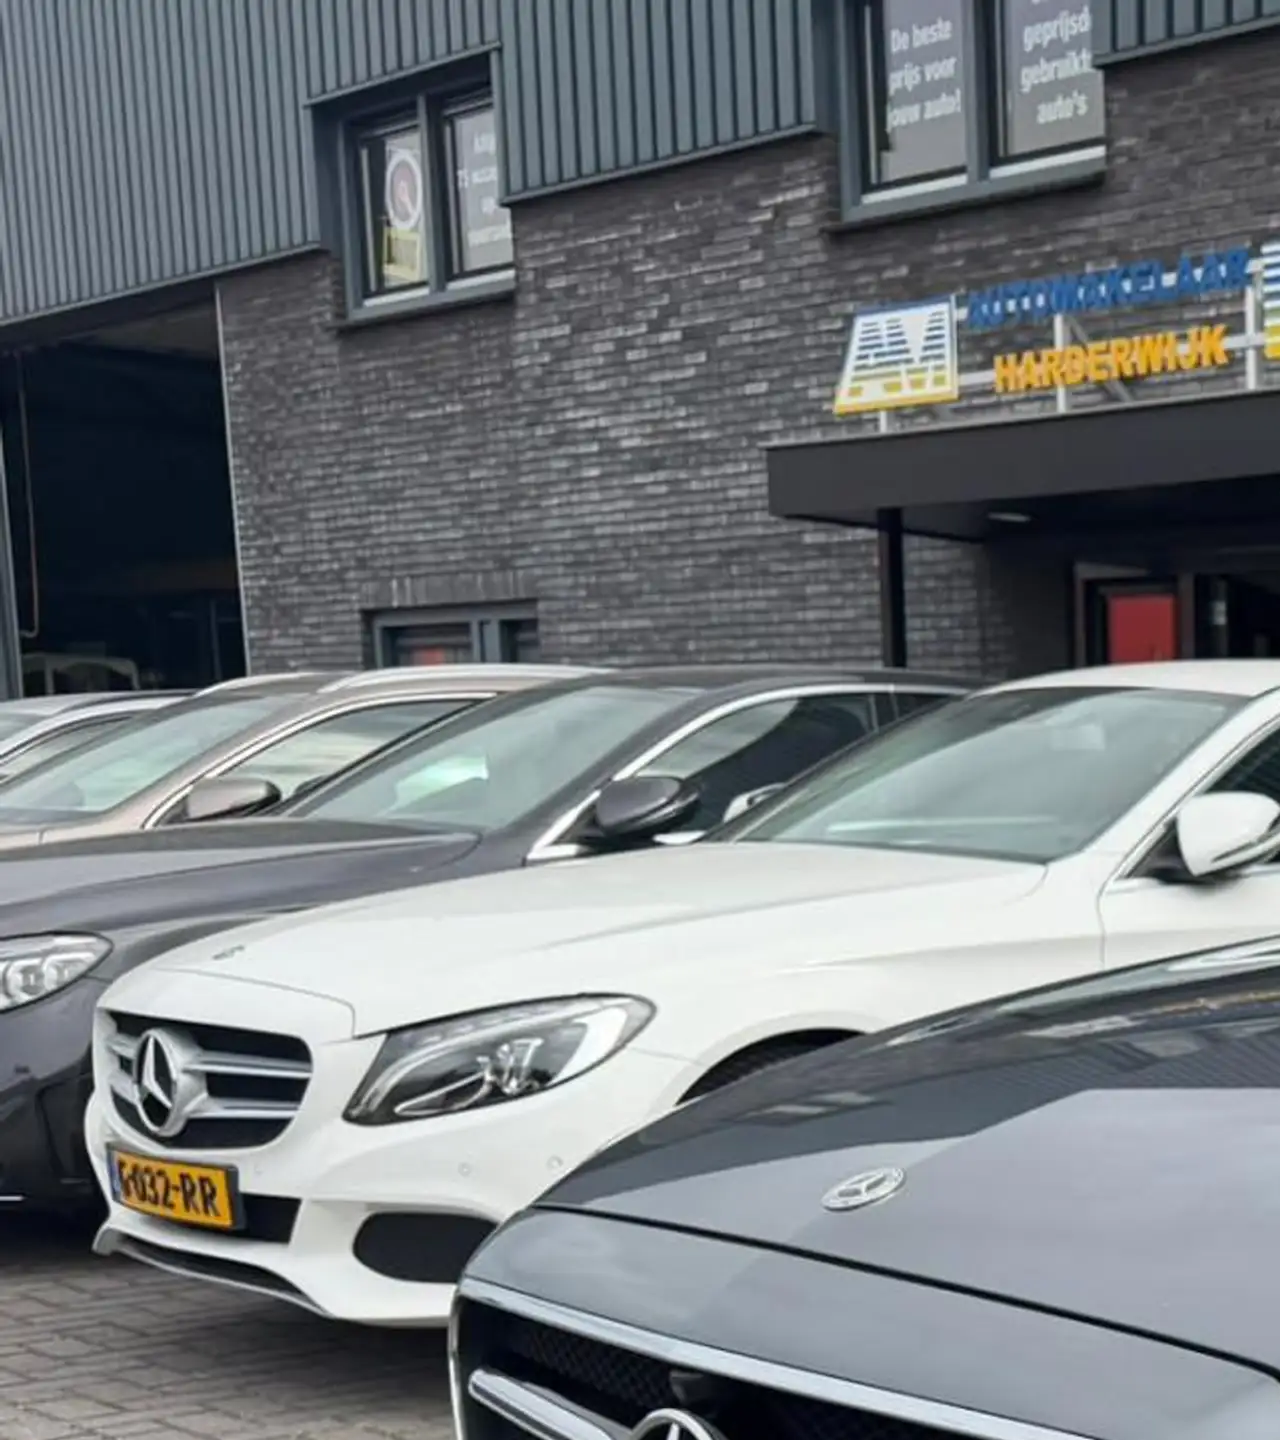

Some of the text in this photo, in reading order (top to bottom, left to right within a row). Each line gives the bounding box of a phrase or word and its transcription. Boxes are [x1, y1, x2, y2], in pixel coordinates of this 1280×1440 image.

[890, 17, 952, 53] De beste
[889, 57, 957, 95] prijs voor
[924, 88, 961, 119] auto!
[1036, 90, 1088, 124] auto's
[966, 246, 1250, 330] AUTOMAKELAAR
[994, 323, 1229, 393] HARDERWIJK
